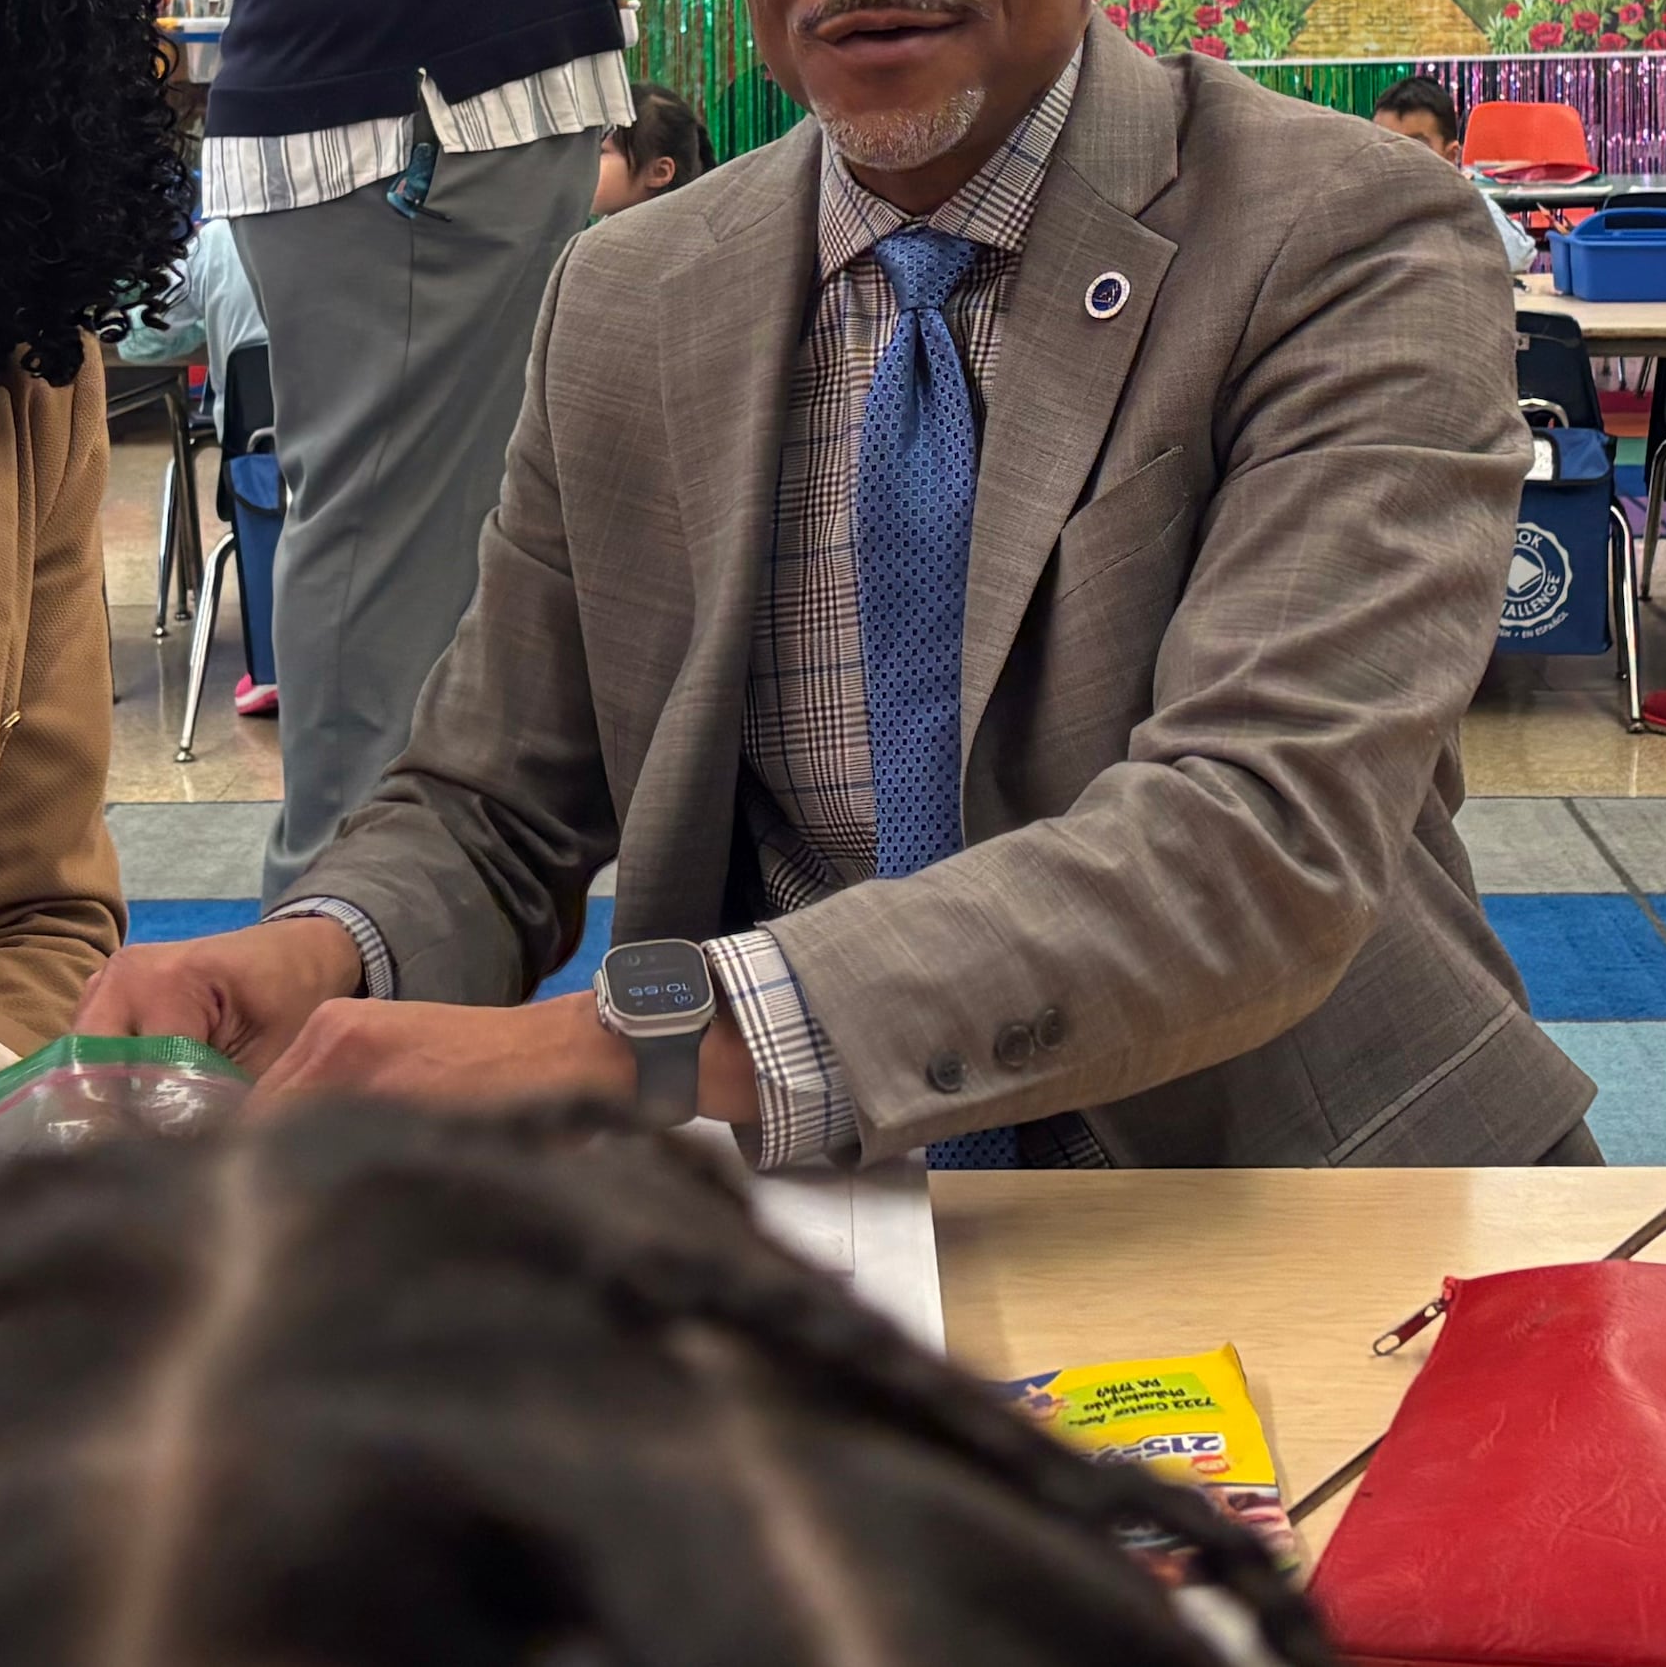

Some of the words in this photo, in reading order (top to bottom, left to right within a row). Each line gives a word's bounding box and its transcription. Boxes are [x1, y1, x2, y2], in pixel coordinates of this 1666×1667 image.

[1501, 569, 1562, 619] ALLENGE
[1137, 1378, 1162, 1389] PA
[1083, 1388, 1186, 1412] Philadelphia
[1112, 1400, 1170, 1418] Castor
